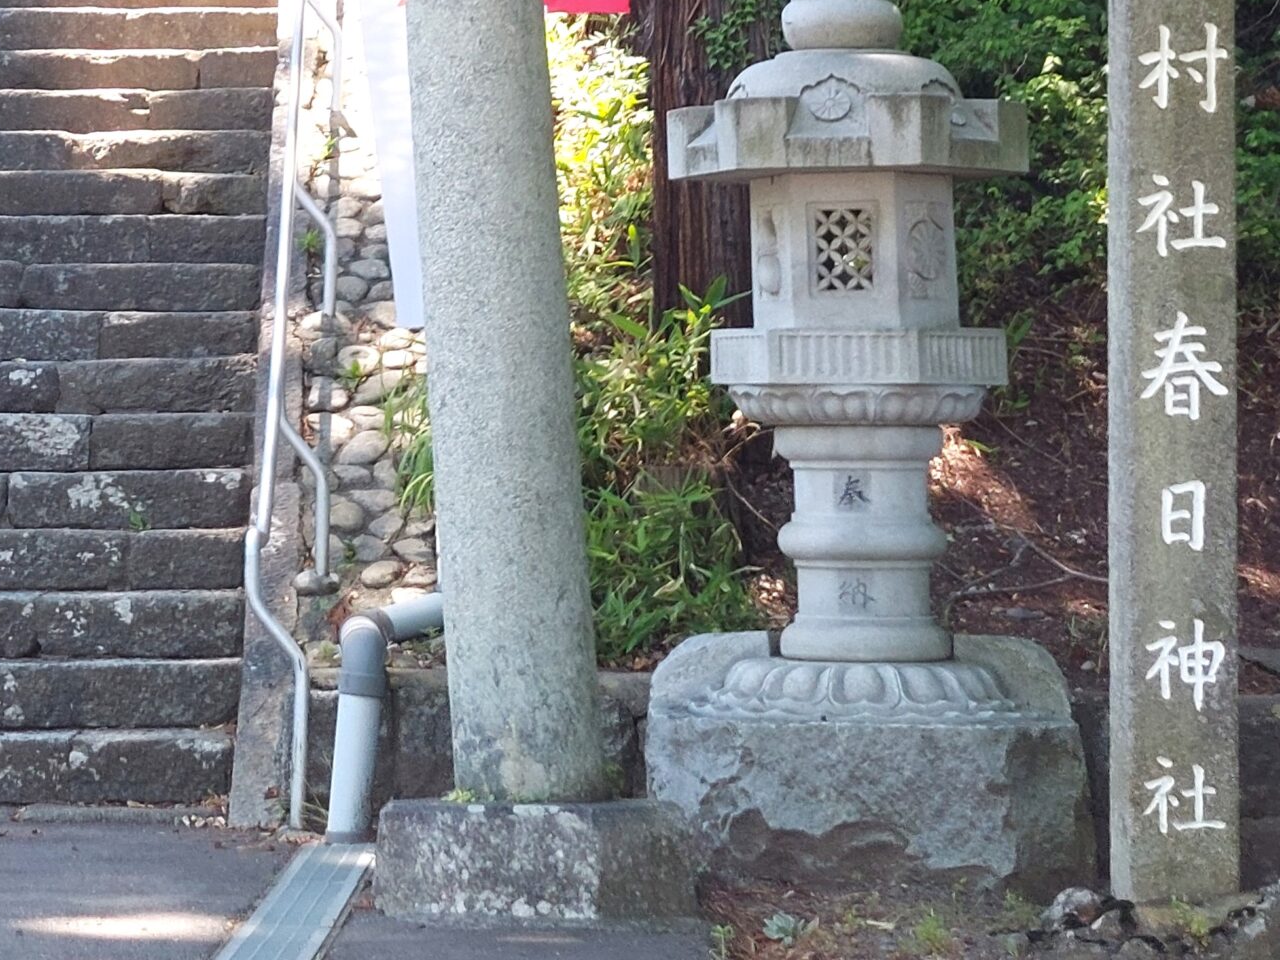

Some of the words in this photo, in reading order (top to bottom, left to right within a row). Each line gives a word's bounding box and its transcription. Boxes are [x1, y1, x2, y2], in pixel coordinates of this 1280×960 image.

[1136, 22, 1229, 837] 村社春日神社
